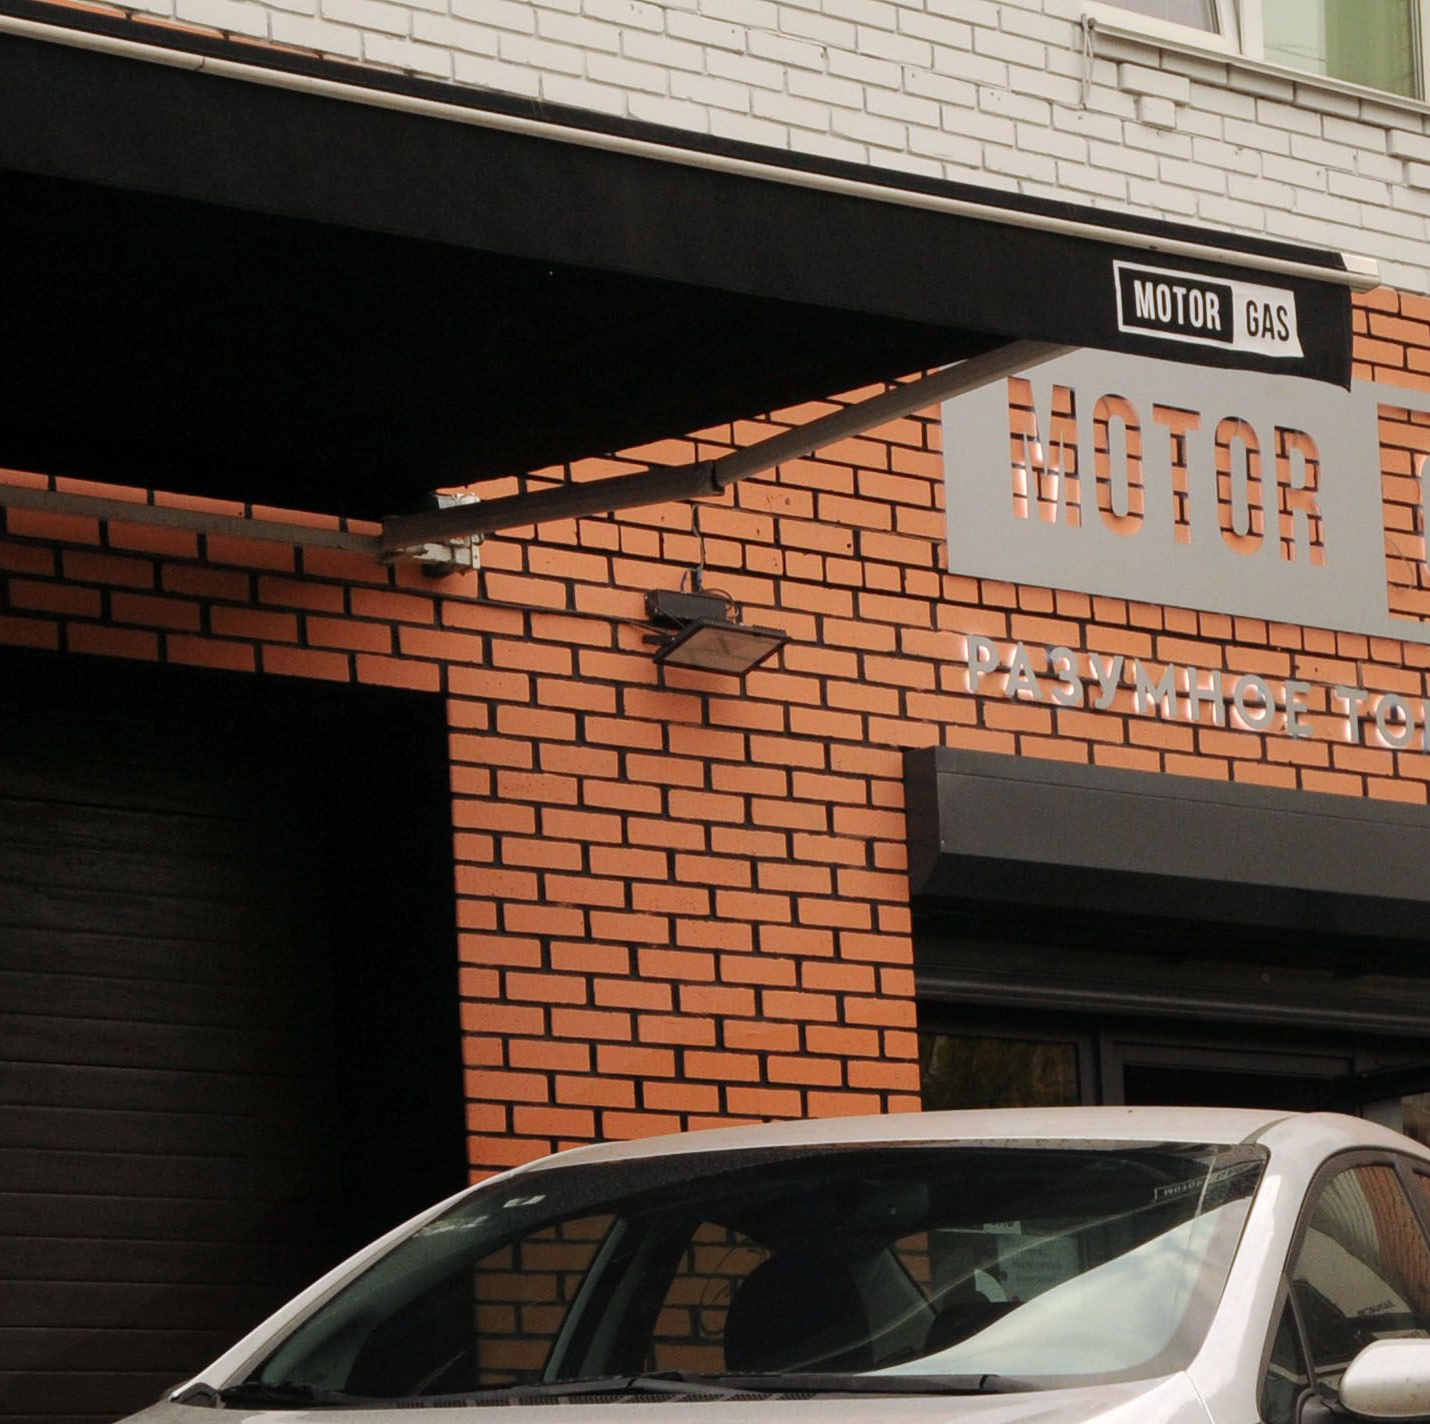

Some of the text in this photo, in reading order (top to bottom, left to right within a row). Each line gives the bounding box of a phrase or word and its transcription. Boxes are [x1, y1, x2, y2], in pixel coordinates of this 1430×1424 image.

[1133, 279, 1290, 342] MOTOR GAS
[1007, 376, 1328, 568] MOTOR
[966, 633, 1315, 738] РАЗУМНОЕ
